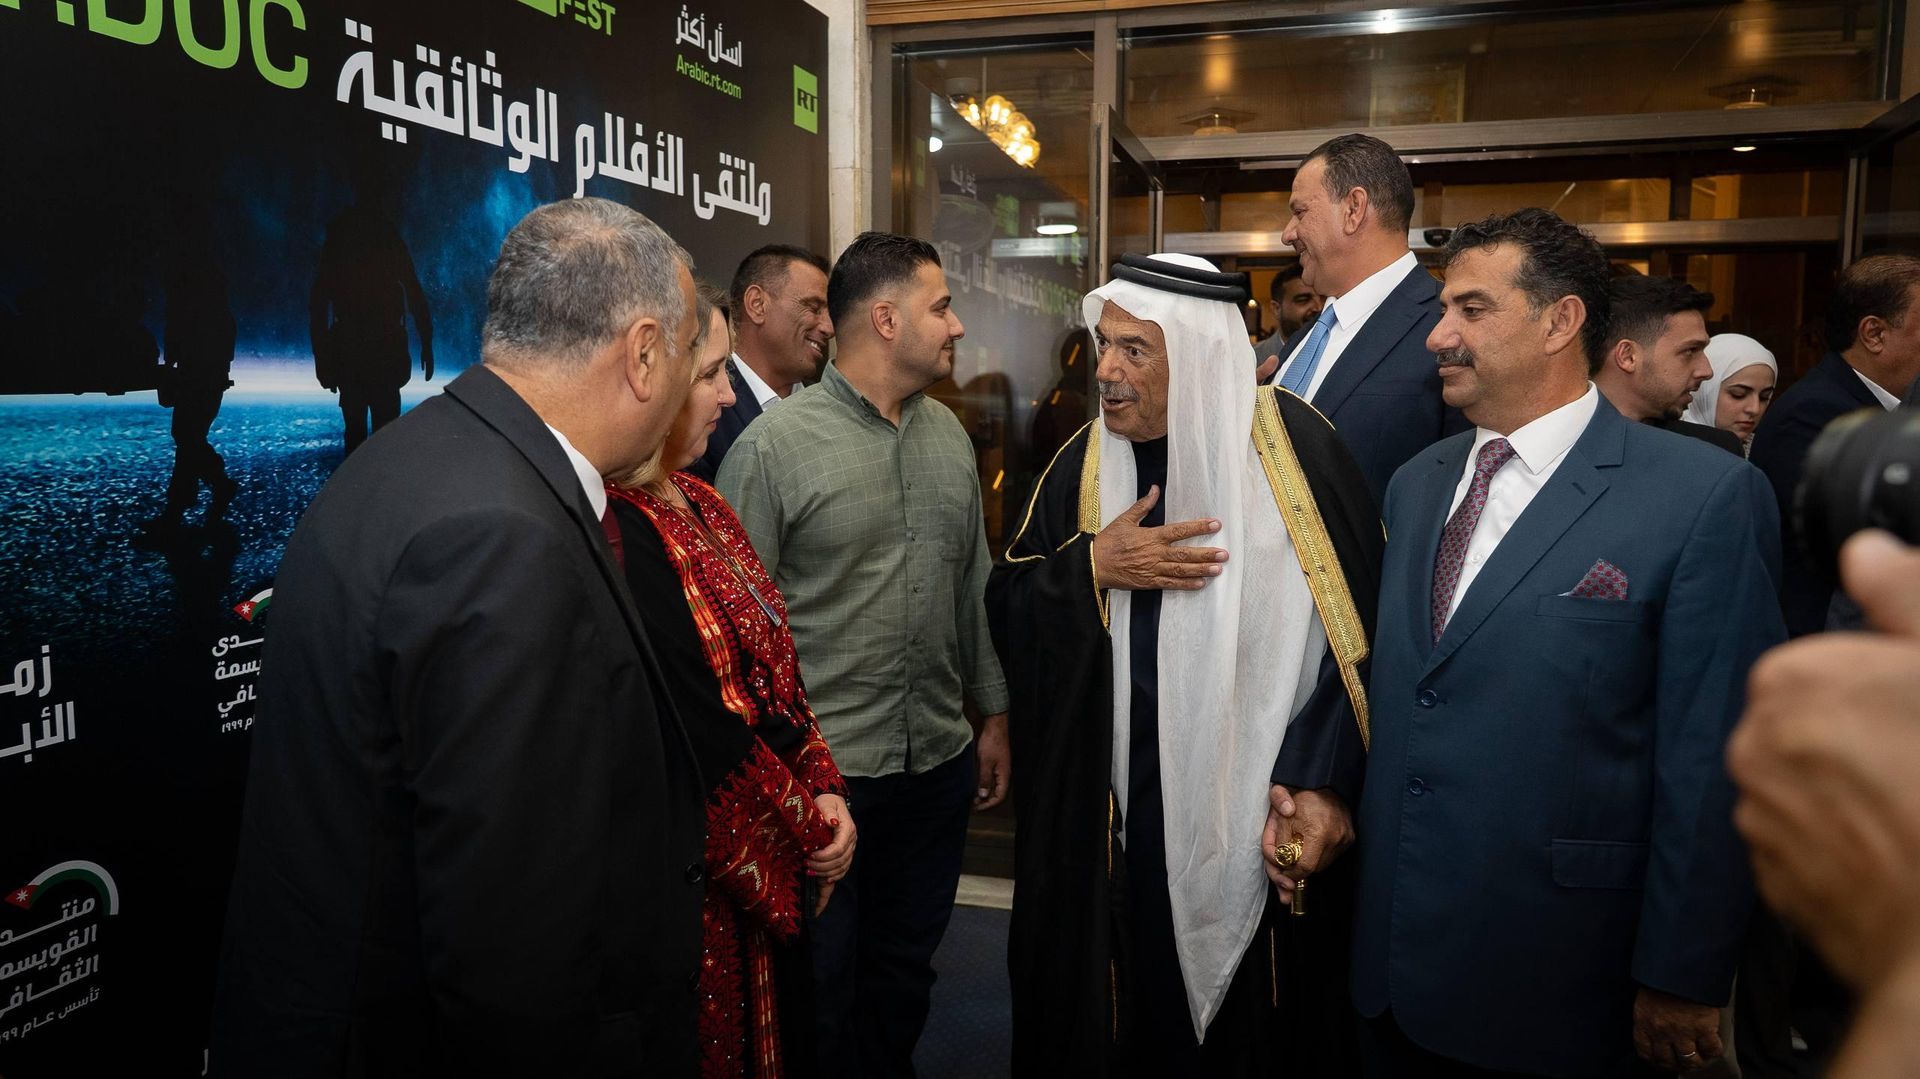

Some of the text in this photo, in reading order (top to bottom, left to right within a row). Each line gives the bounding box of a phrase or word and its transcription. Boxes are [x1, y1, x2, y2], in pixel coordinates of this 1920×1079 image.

[676, 4, 742, 67] اسأل أكثر
[676, 54, 742, 99] Arabic.rt.com
[797, 87, 818, 113] RT
[336, 18, 771, 226] ملتقى الأفلام الوثائقية
[0, 645, 51, 697] زم
[0, 701, 76, 763] الأب
[0, 898, 95, 946] منتد
[0, 924, 97, 980] القويسم
[21, 1011, 55, 1038] عام
